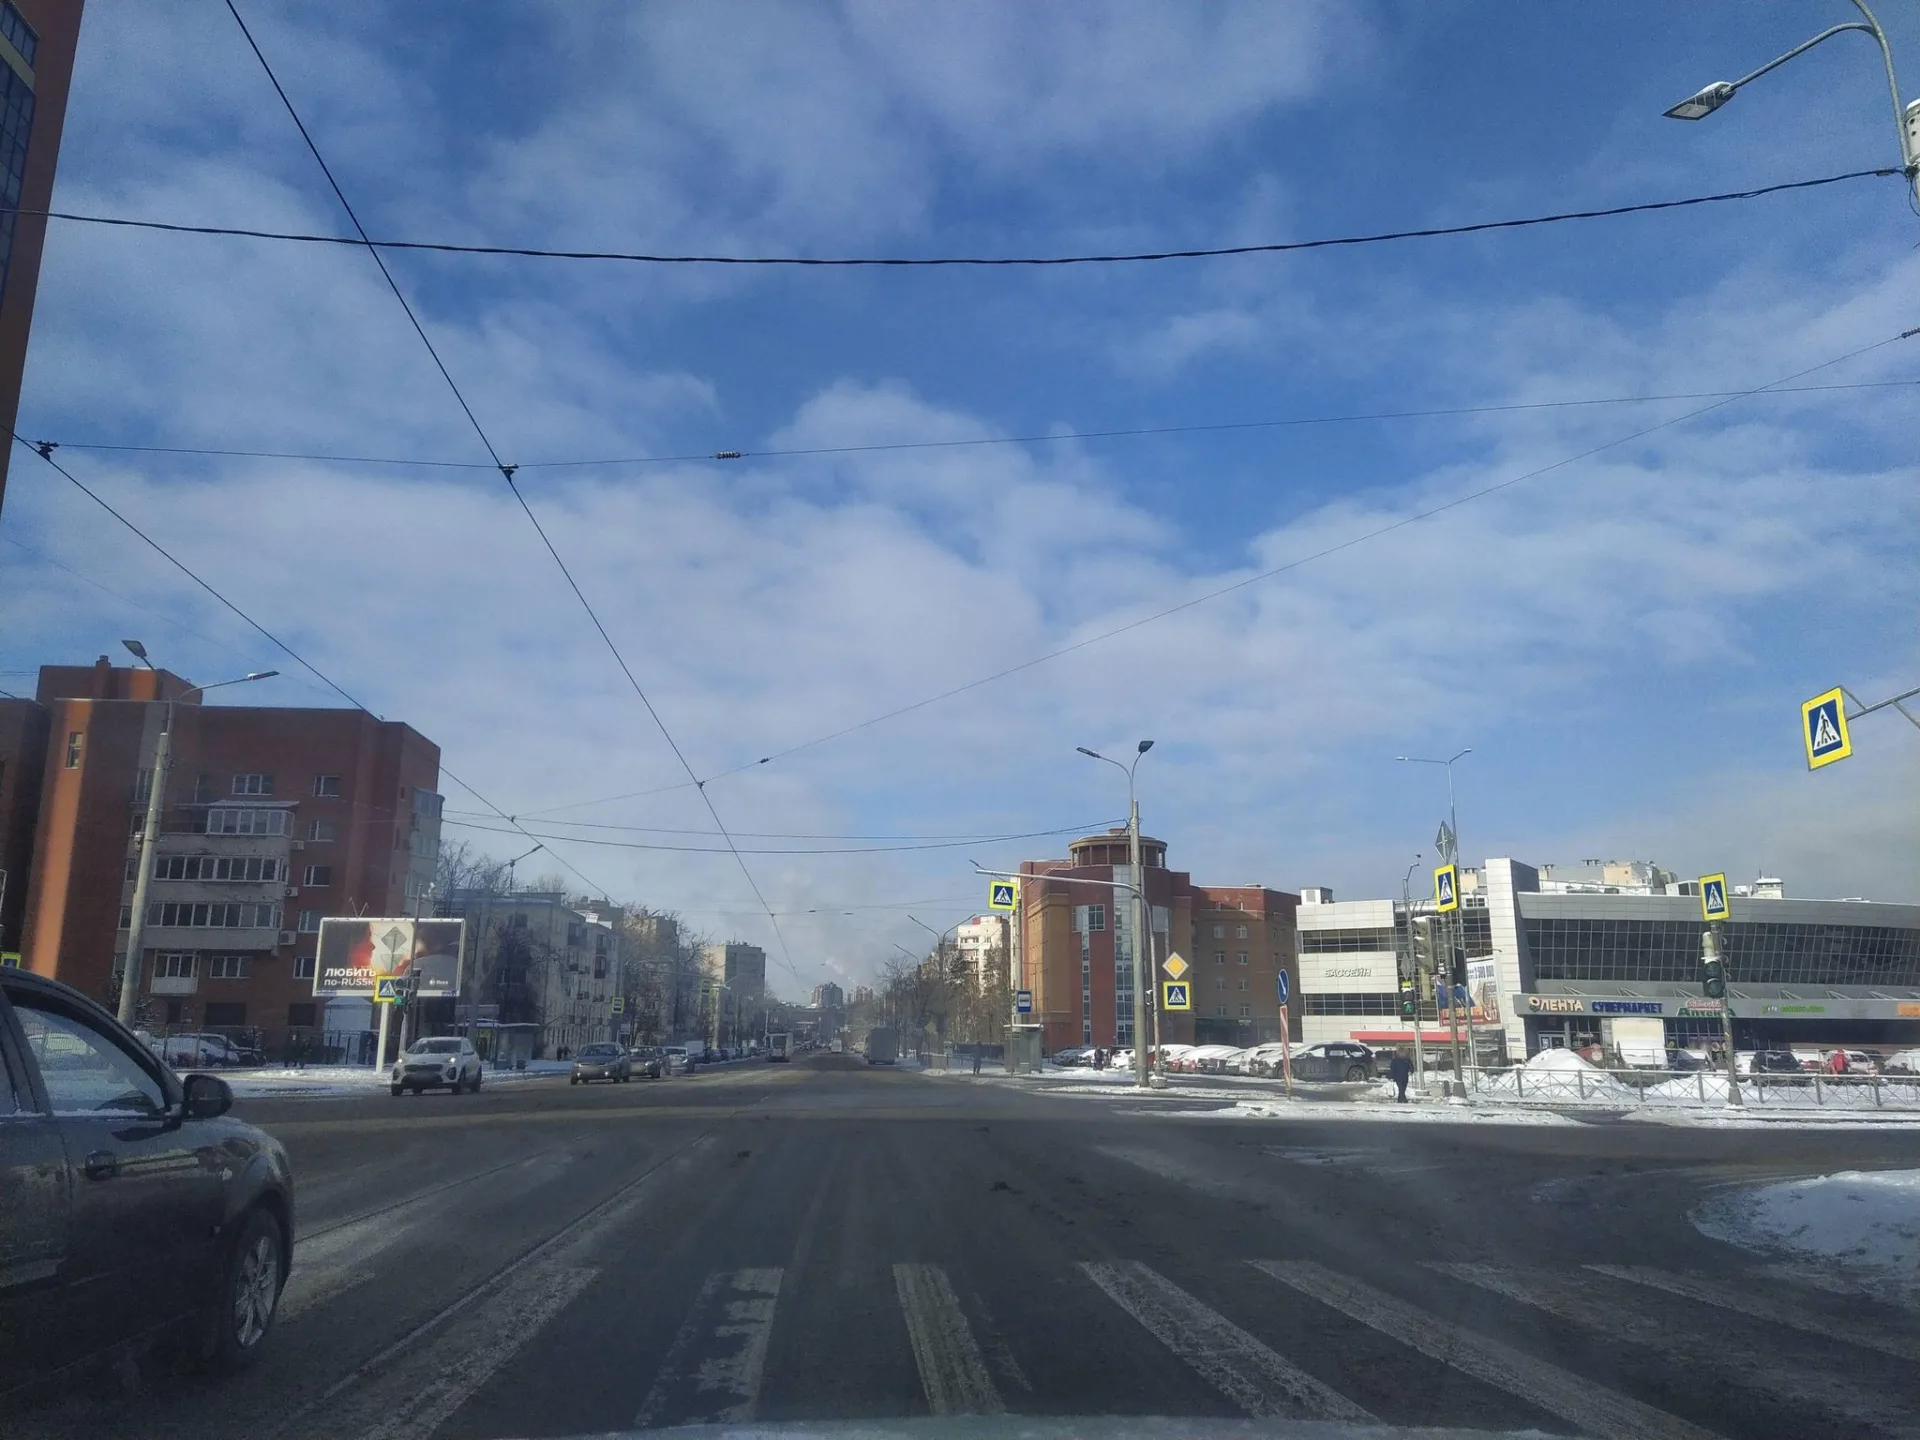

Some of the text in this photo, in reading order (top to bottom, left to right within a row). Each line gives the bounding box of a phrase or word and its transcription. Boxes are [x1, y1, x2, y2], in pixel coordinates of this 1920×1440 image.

[324, 968, 376, 977] ЛЮБИТЬ
[1325, 967, 1372, 977] БАССЕЙН
[1540, 999, 1663, 1014] ЛЕНТА СУПЕРМАРКЕТ
